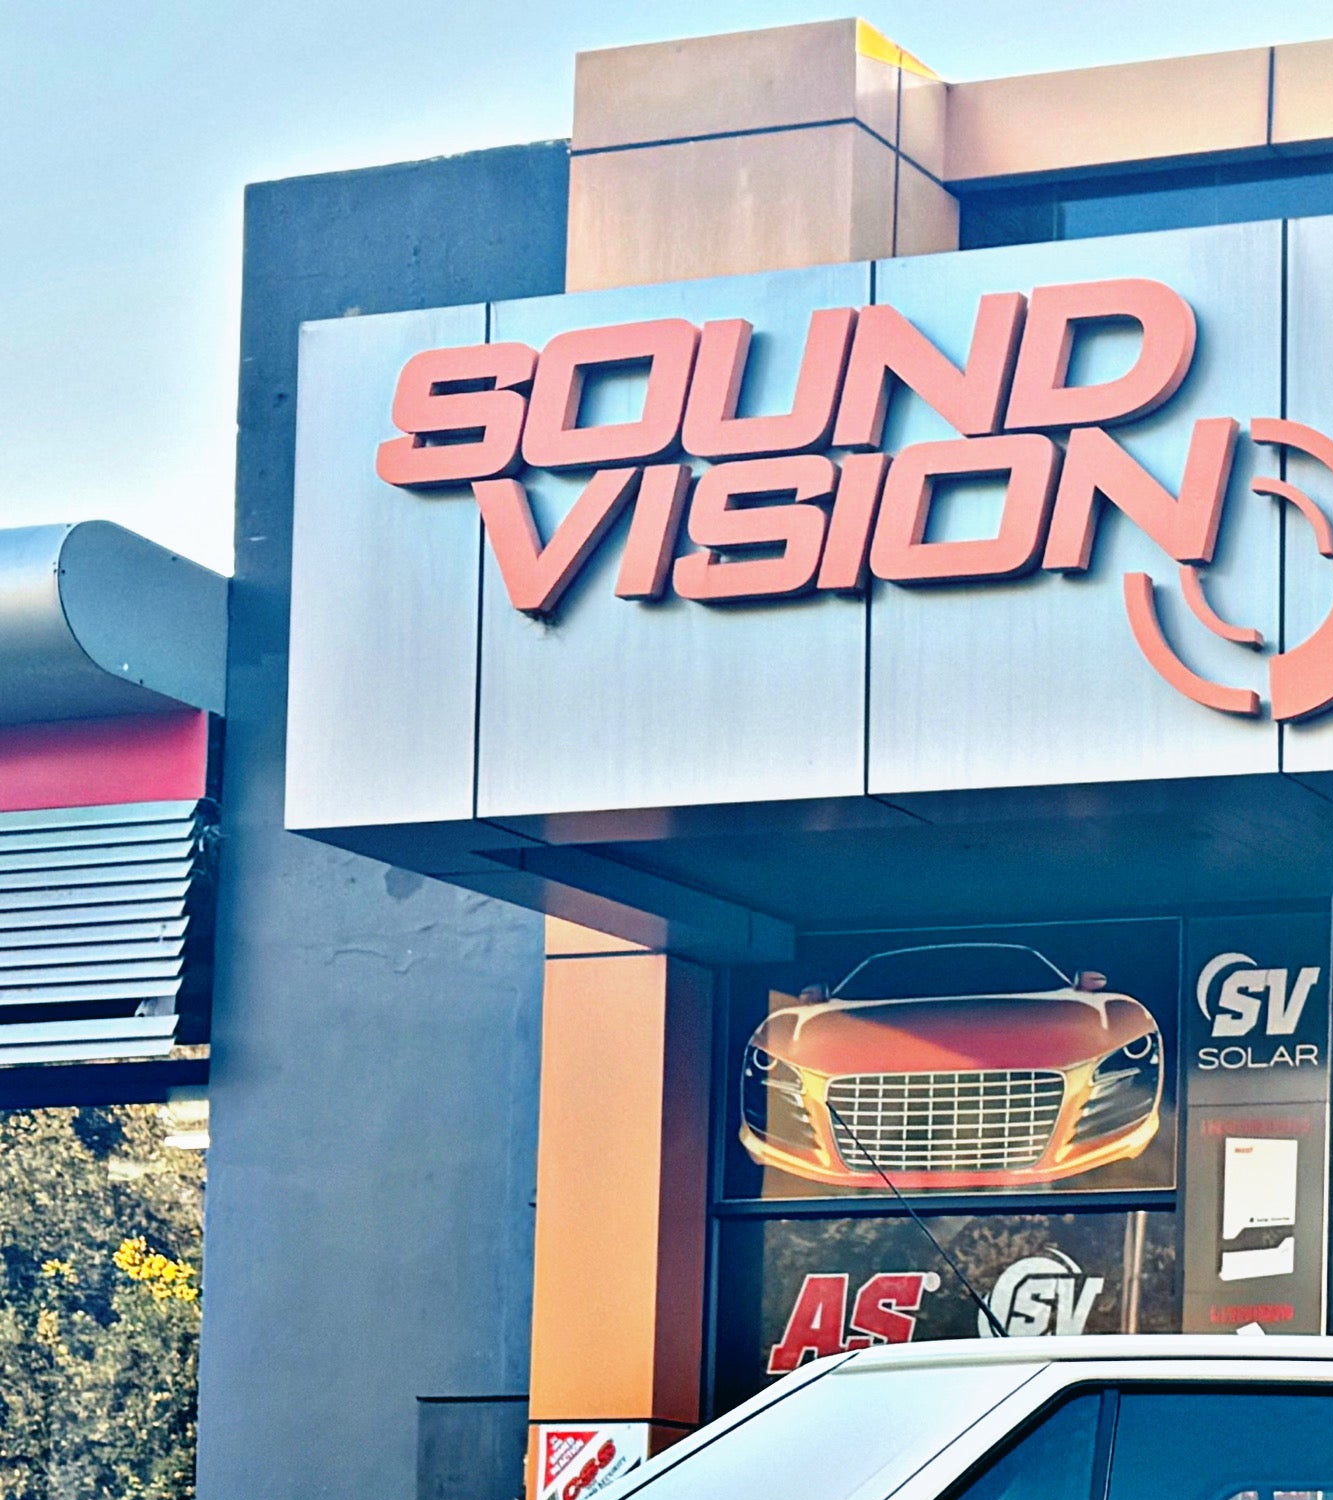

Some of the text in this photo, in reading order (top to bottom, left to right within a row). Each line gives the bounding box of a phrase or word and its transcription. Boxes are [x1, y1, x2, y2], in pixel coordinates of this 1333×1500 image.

[375, 278, 1197, 488] SOUND
[470, 416, 1240, 614] VISION
[1211, 966, 1321, 1037] SV
[1198, 1044, 1319, 1070] SOLAR
[766, 1272, 926, 1375] AS
